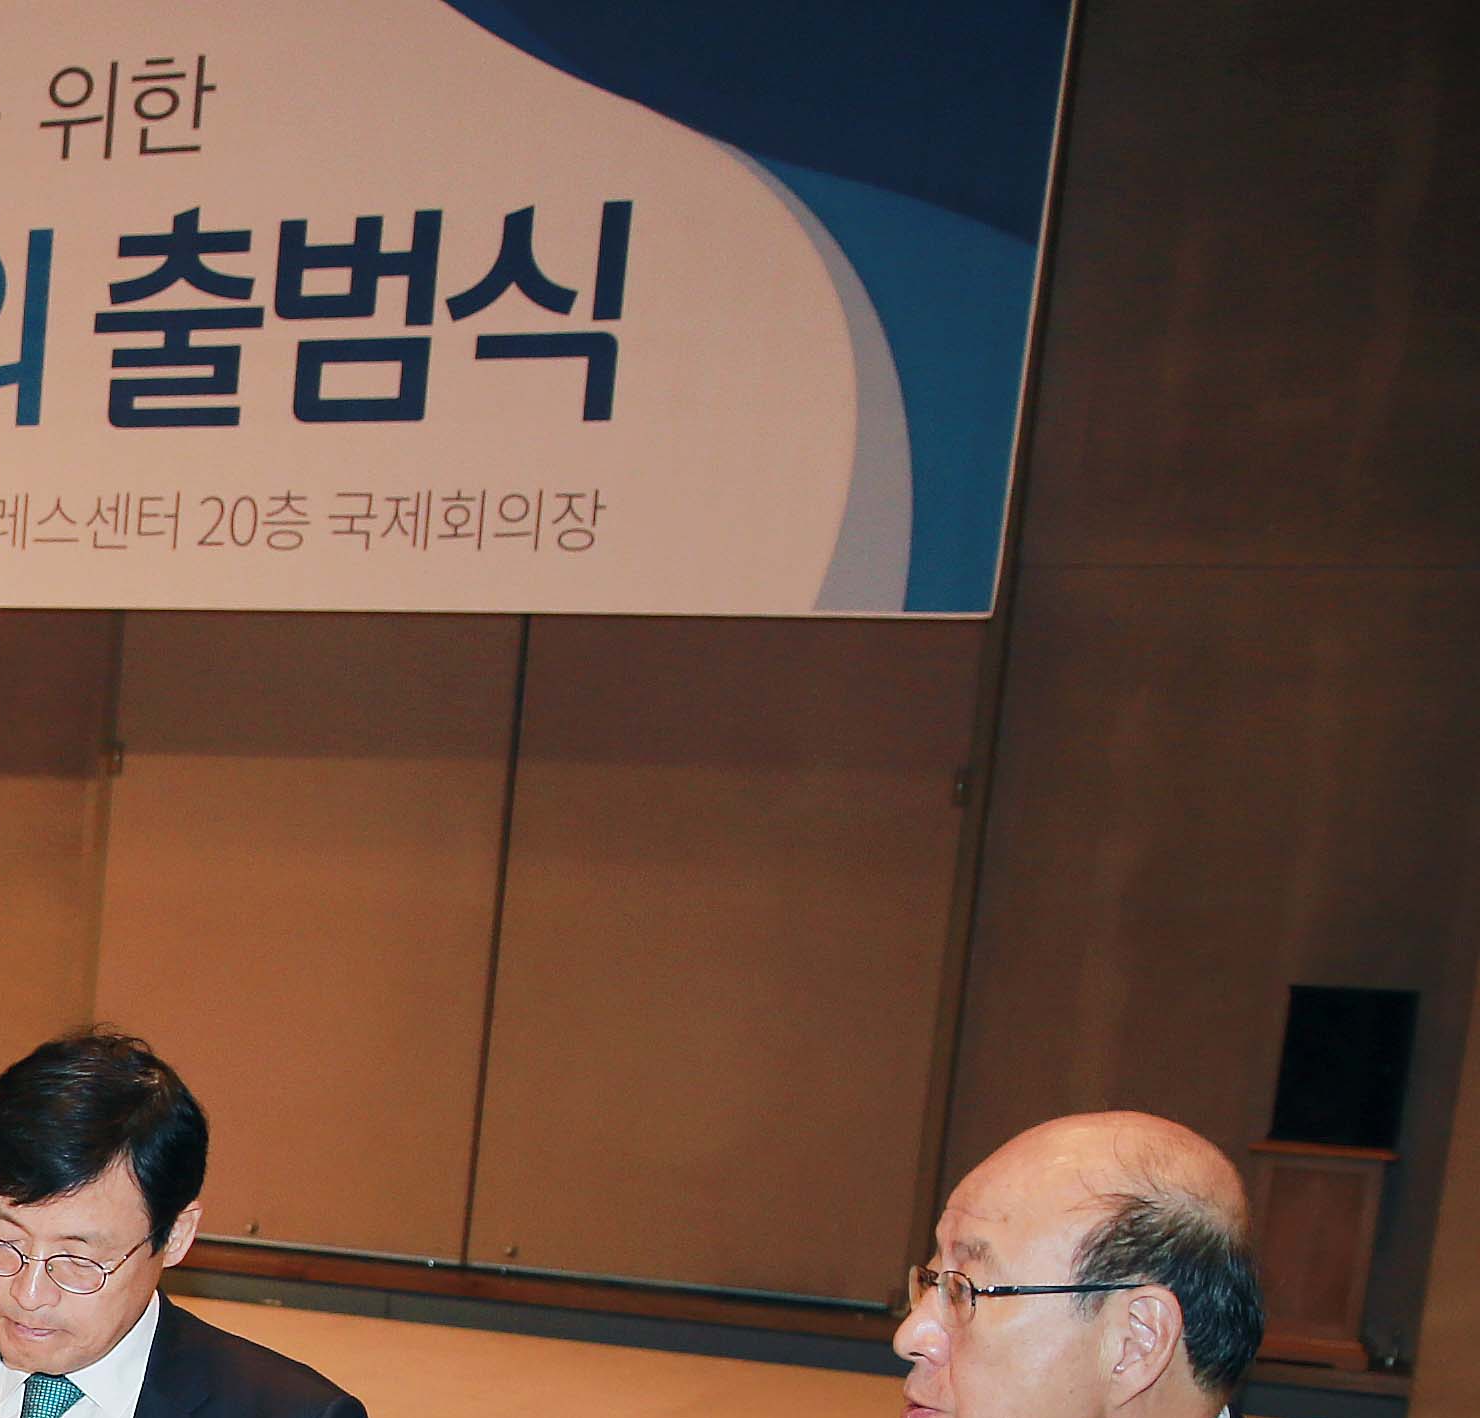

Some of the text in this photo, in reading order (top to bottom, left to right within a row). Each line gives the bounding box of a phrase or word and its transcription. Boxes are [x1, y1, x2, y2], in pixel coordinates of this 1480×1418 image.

[38, 54, 218, 162] 위한
[92, 200, 634, 430] 출범식
[196, 488, 312, 552] 20층
[326, 487, 608, 553] 국제회의장
